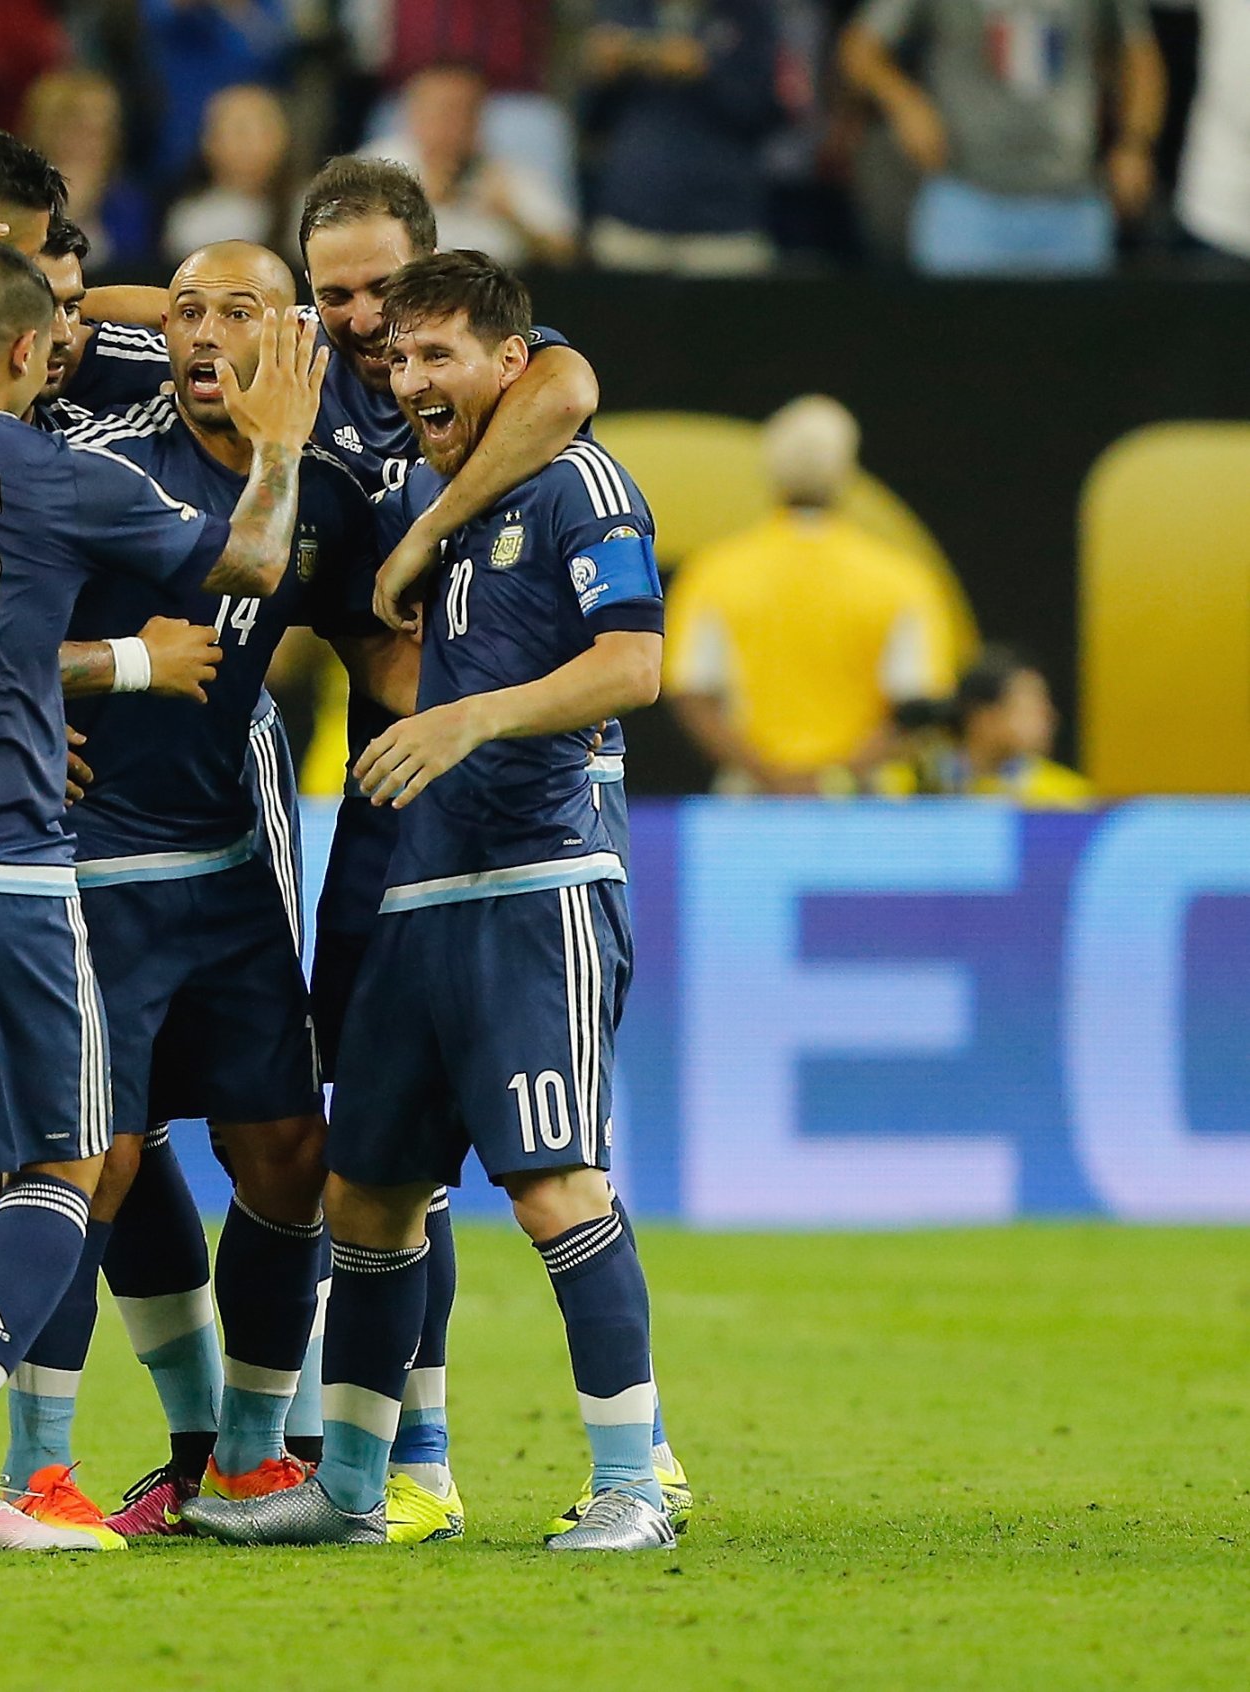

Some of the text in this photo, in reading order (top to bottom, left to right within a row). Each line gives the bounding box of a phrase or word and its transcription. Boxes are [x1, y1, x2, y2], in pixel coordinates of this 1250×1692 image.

[213, 594, 261, 646] 14
[446, 558, 473, 640] 10
[508, 1070, 573, 1153] 10
